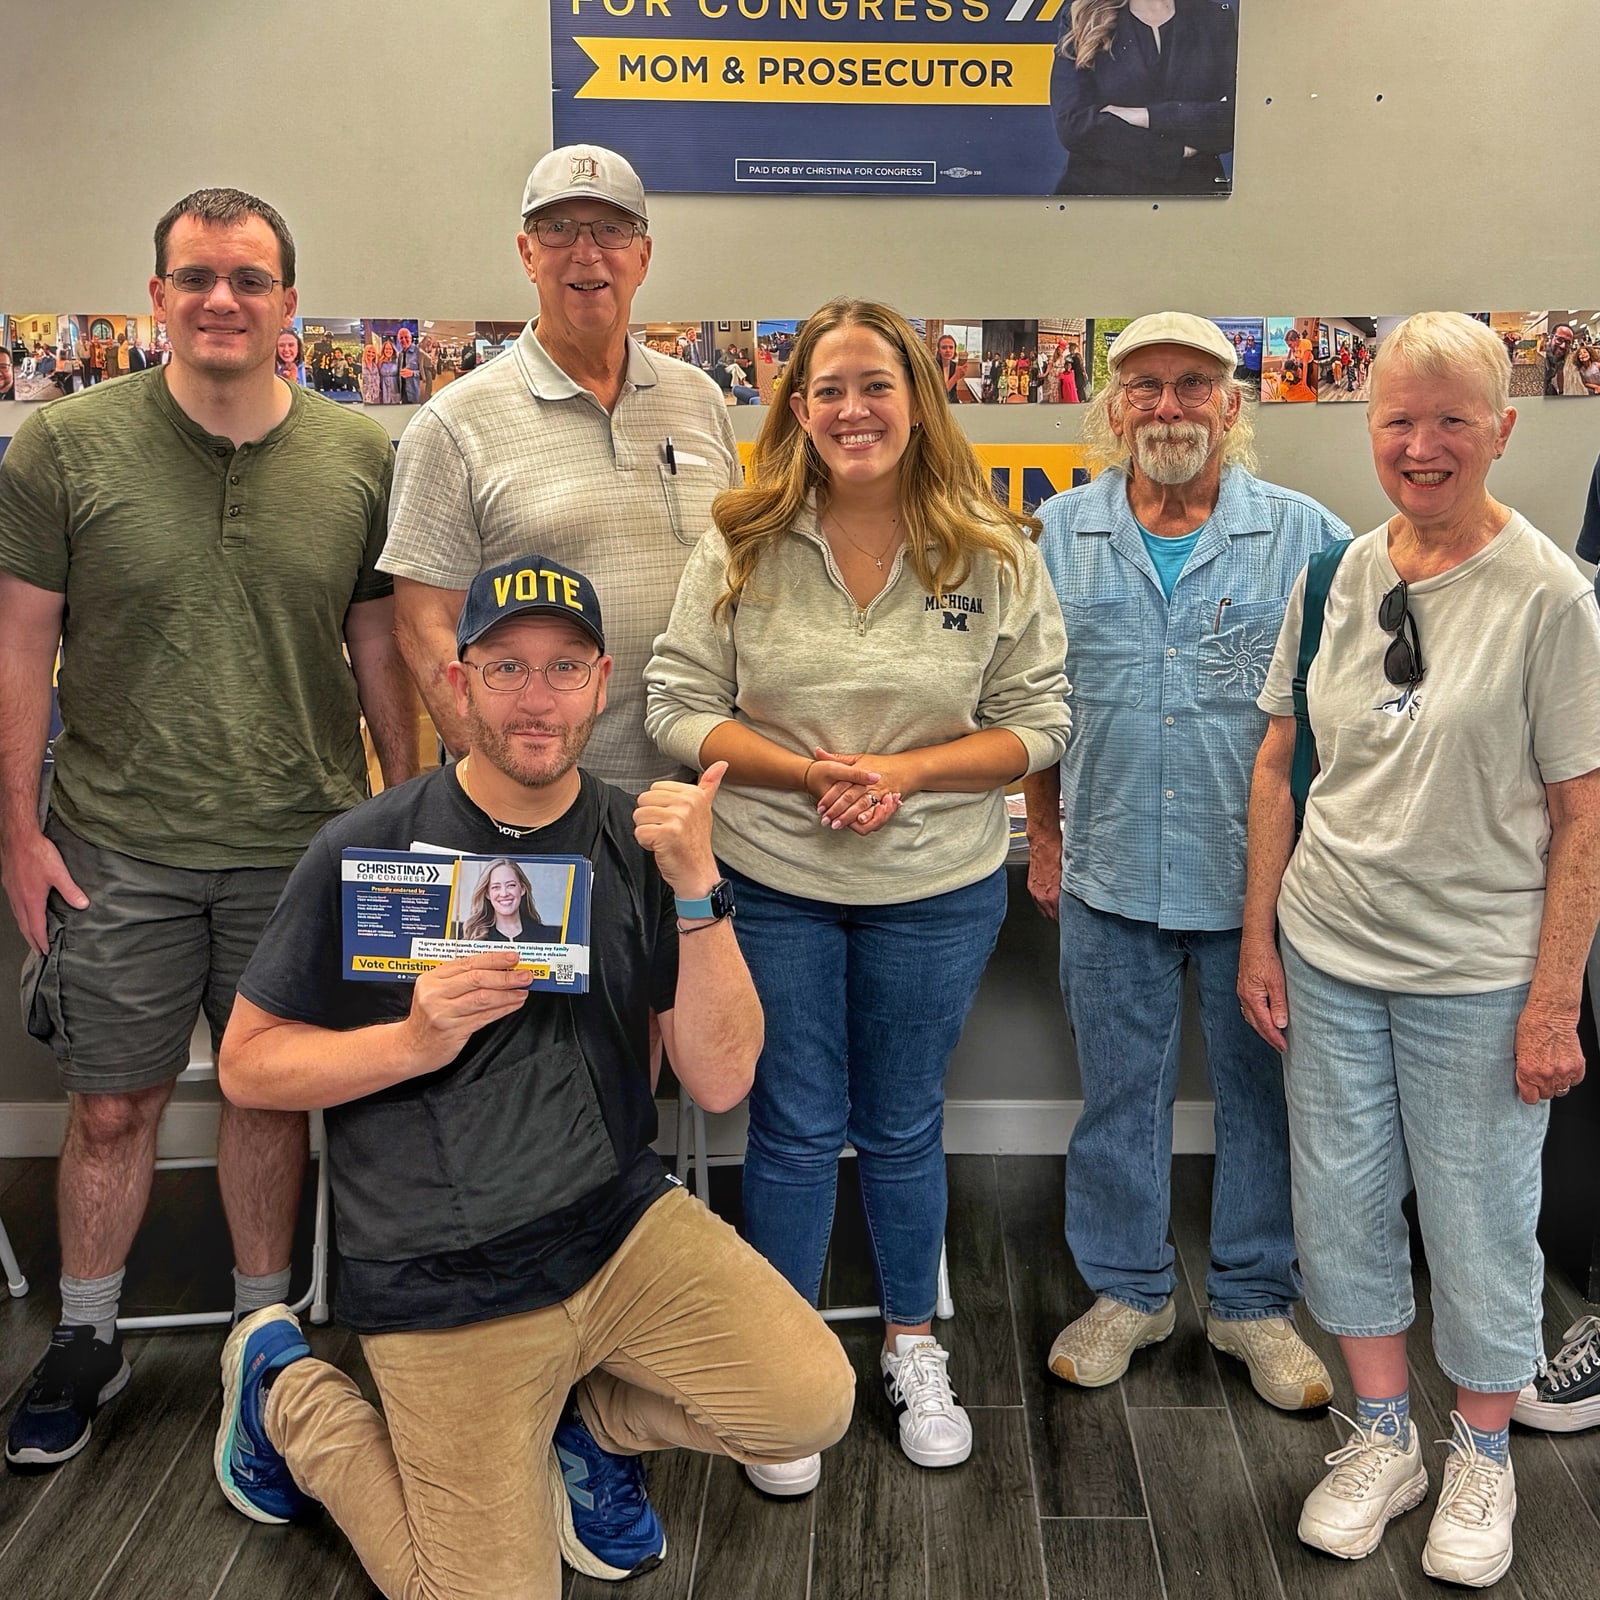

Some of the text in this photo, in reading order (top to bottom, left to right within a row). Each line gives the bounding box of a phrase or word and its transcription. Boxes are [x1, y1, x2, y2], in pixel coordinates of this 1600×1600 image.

[698, 0, 990, 22] CONGRESS
[619, 54, 1013, 88] MOM & PROSECUTOR
[749, 166, 923, 176] PAID FOR BY CHRISTINA FOR CONGRESS
[493, 568, 584, 612] VOTE
[924, 594, 984, 614] MICHIGAN
[942, 611, 969, 632] M
[498, 825, 521, 839] VOTE
[357, 862, 425, 876] CHRISTINA
[377, 874, 426, 883] CONGRESS
[358, 958, 437, 972] Vote Christina
